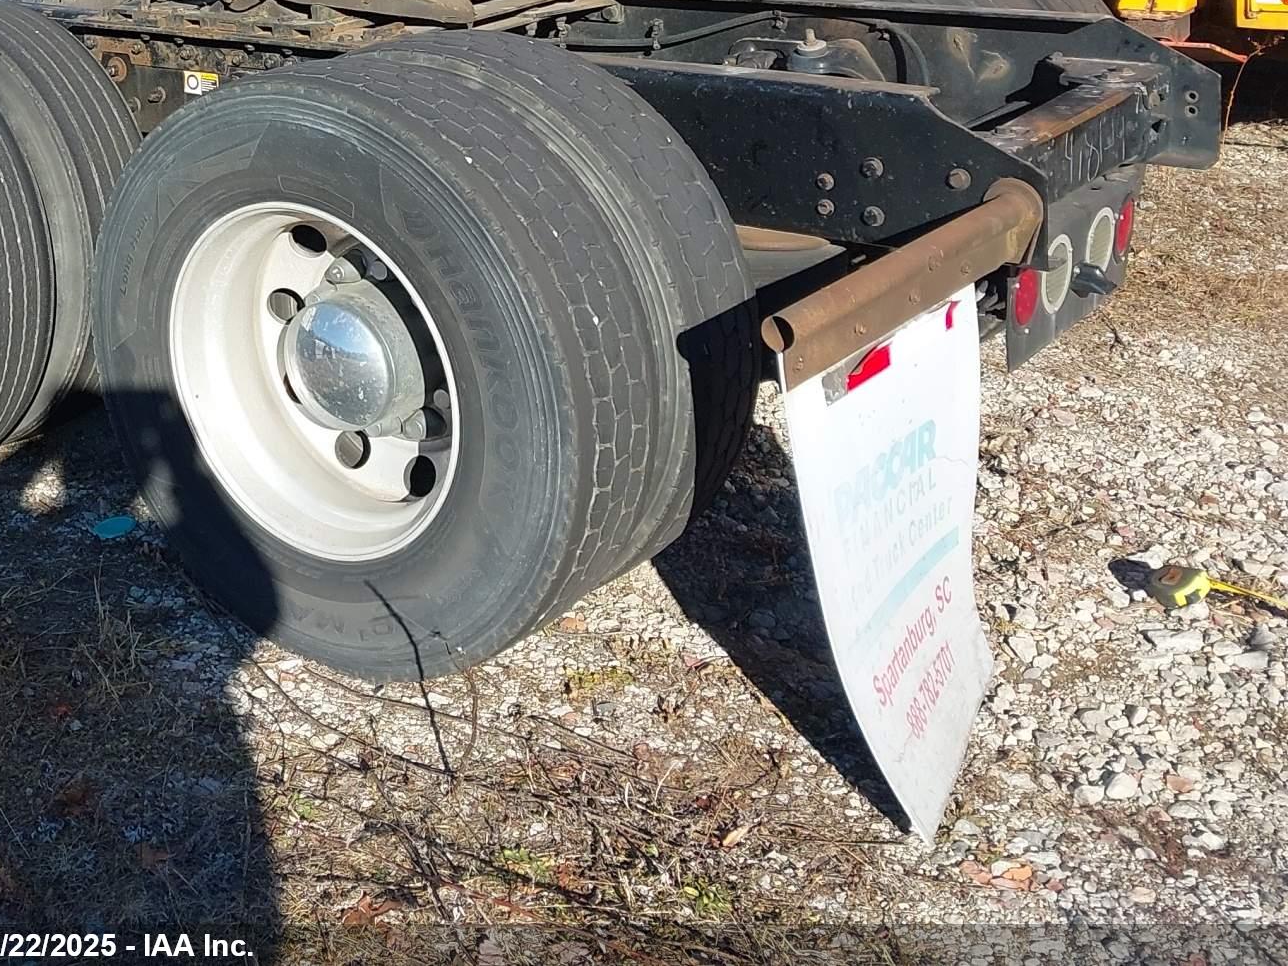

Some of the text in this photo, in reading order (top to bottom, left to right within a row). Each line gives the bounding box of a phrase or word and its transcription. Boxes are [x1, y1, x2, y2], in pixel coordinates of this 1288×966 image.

[832, 418, 937, 524] PACCAR
[909, 495, 953, 547] Center
[873, 574, 953, 708] Spartanburg, SC
[905, 641, 957, 740] 888-782-5701
